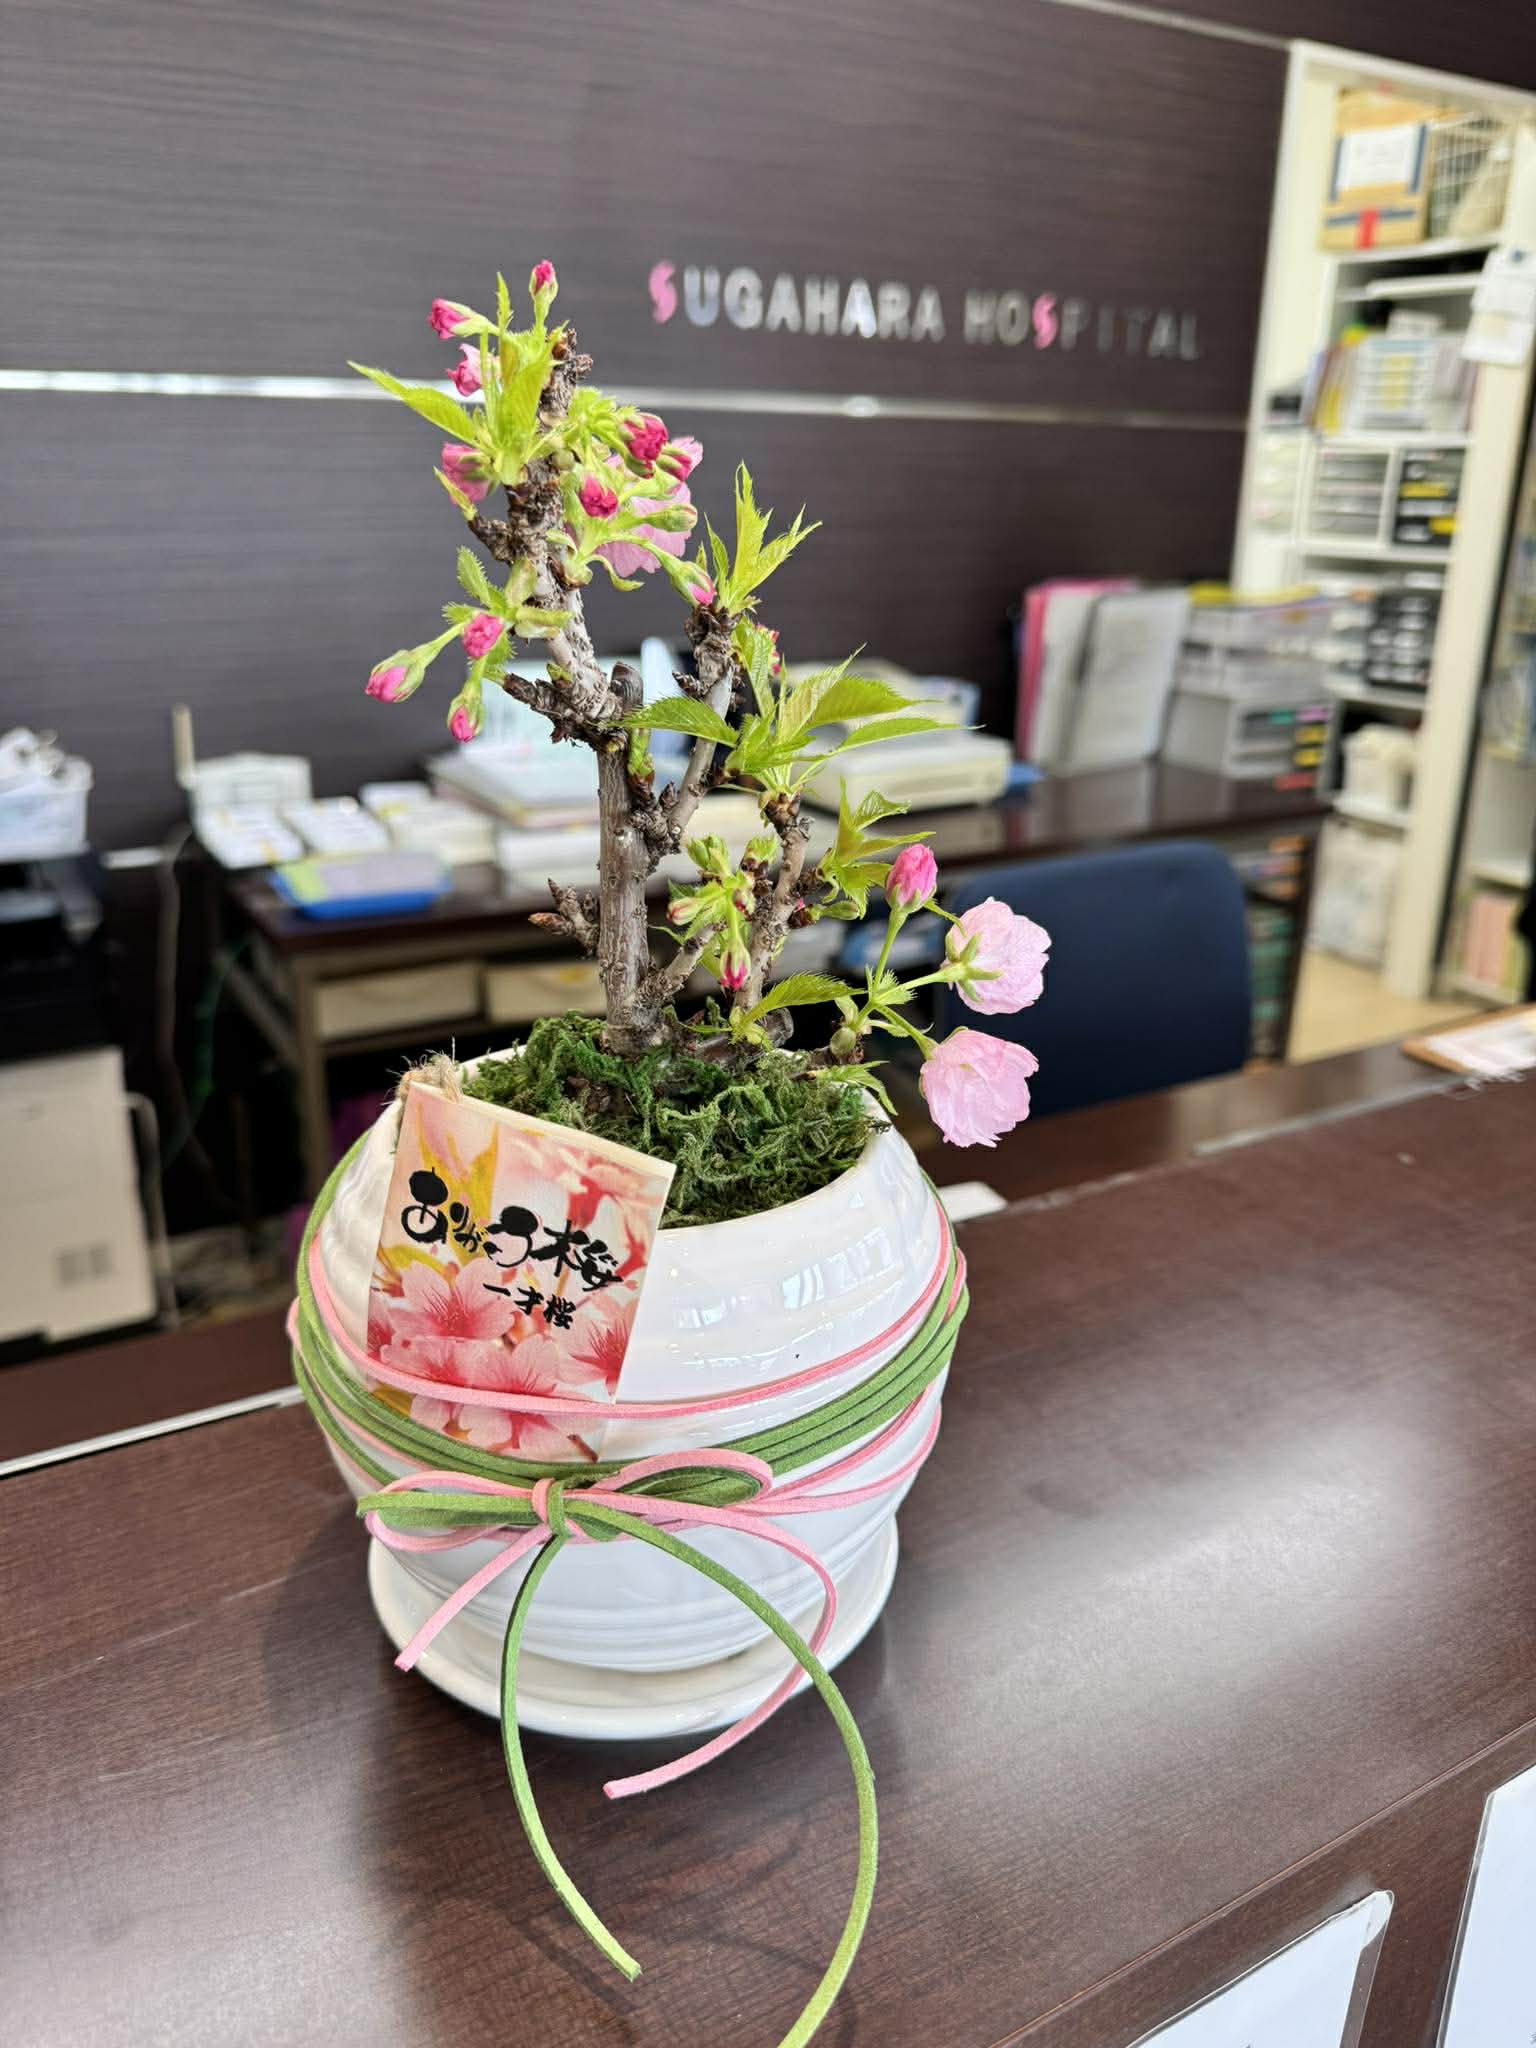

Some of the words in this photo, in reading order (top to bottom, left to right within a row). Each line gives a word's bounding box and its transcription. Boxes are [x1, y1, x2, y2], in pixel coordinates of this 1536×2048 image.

[648, 260, 944, 342] SUGAHARA
[964, 288, 1200, 361] HOSPITAL
[483, 1283, 577, 1330] 一才桜
